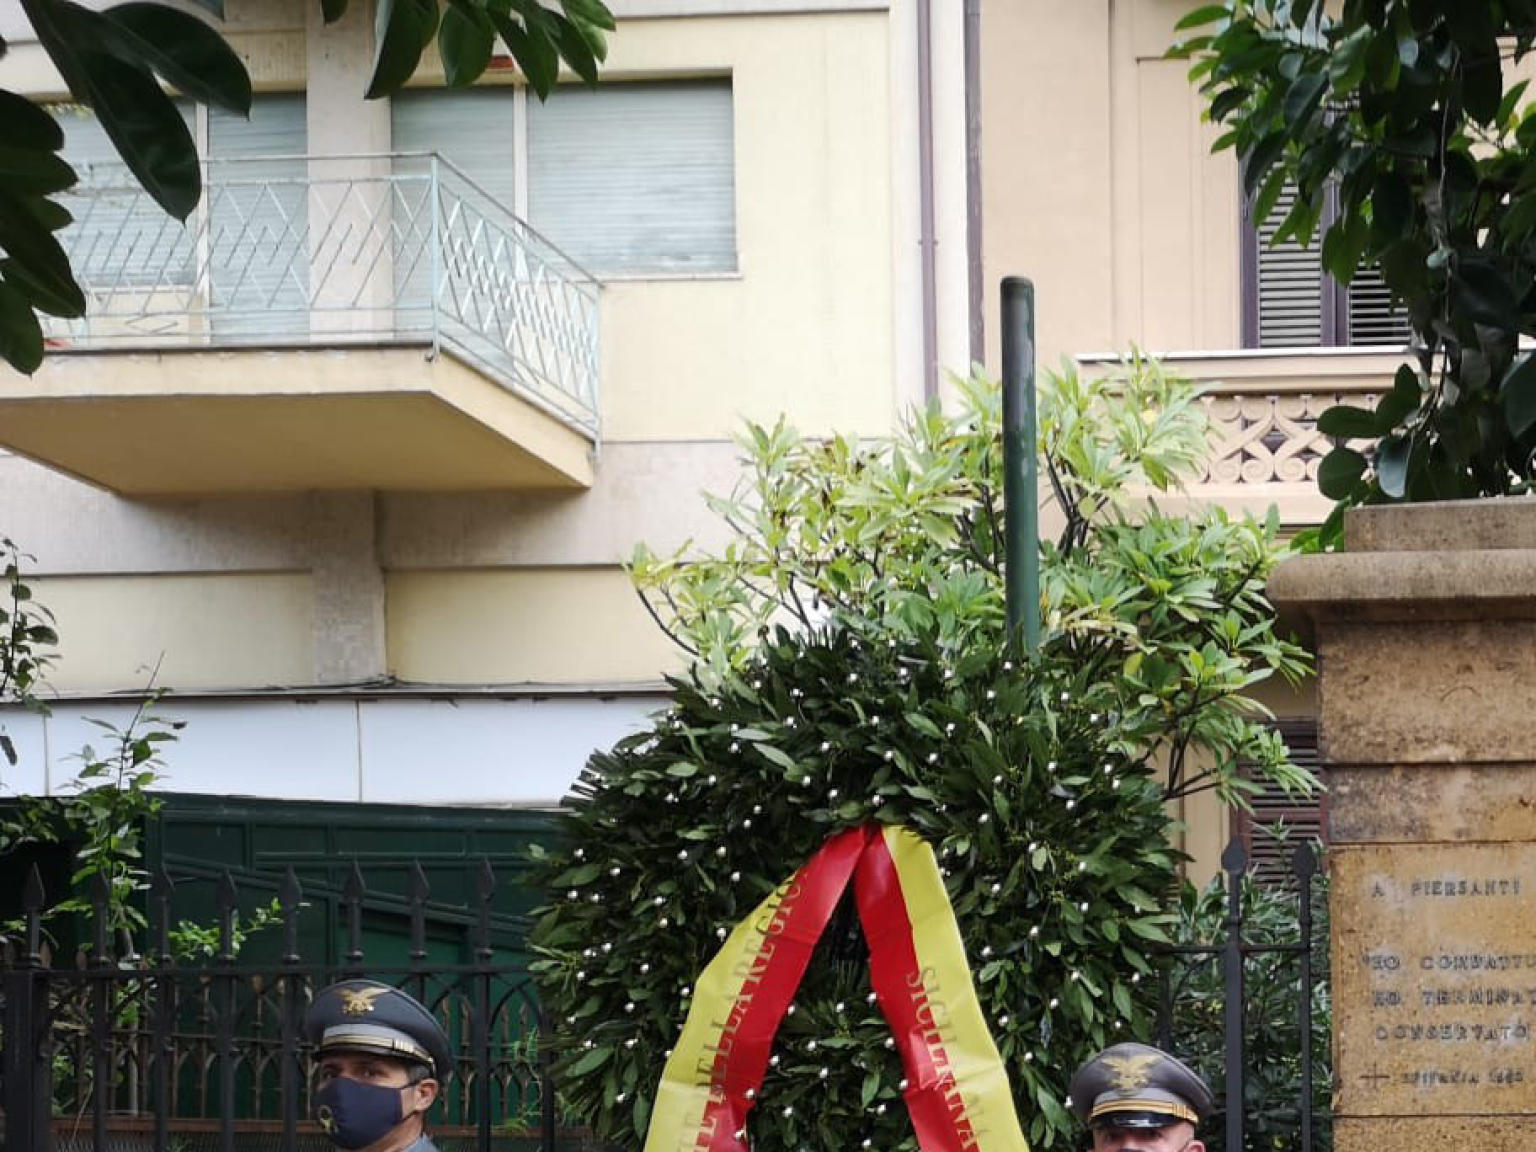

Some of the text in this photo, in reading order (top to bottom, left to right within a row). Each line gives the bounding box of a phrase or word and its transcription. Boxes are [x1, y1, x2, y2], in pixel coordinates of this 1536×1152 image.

[1371, 881, 1385, 897] A
[1411, 880, 1520, 896] PIERSANTI
[696, 990, 755, 1106] DELLA
[907, 966, 992, 1149] SICILIANA
[1376, 1025, 1528, 1041] CONSERVATO
